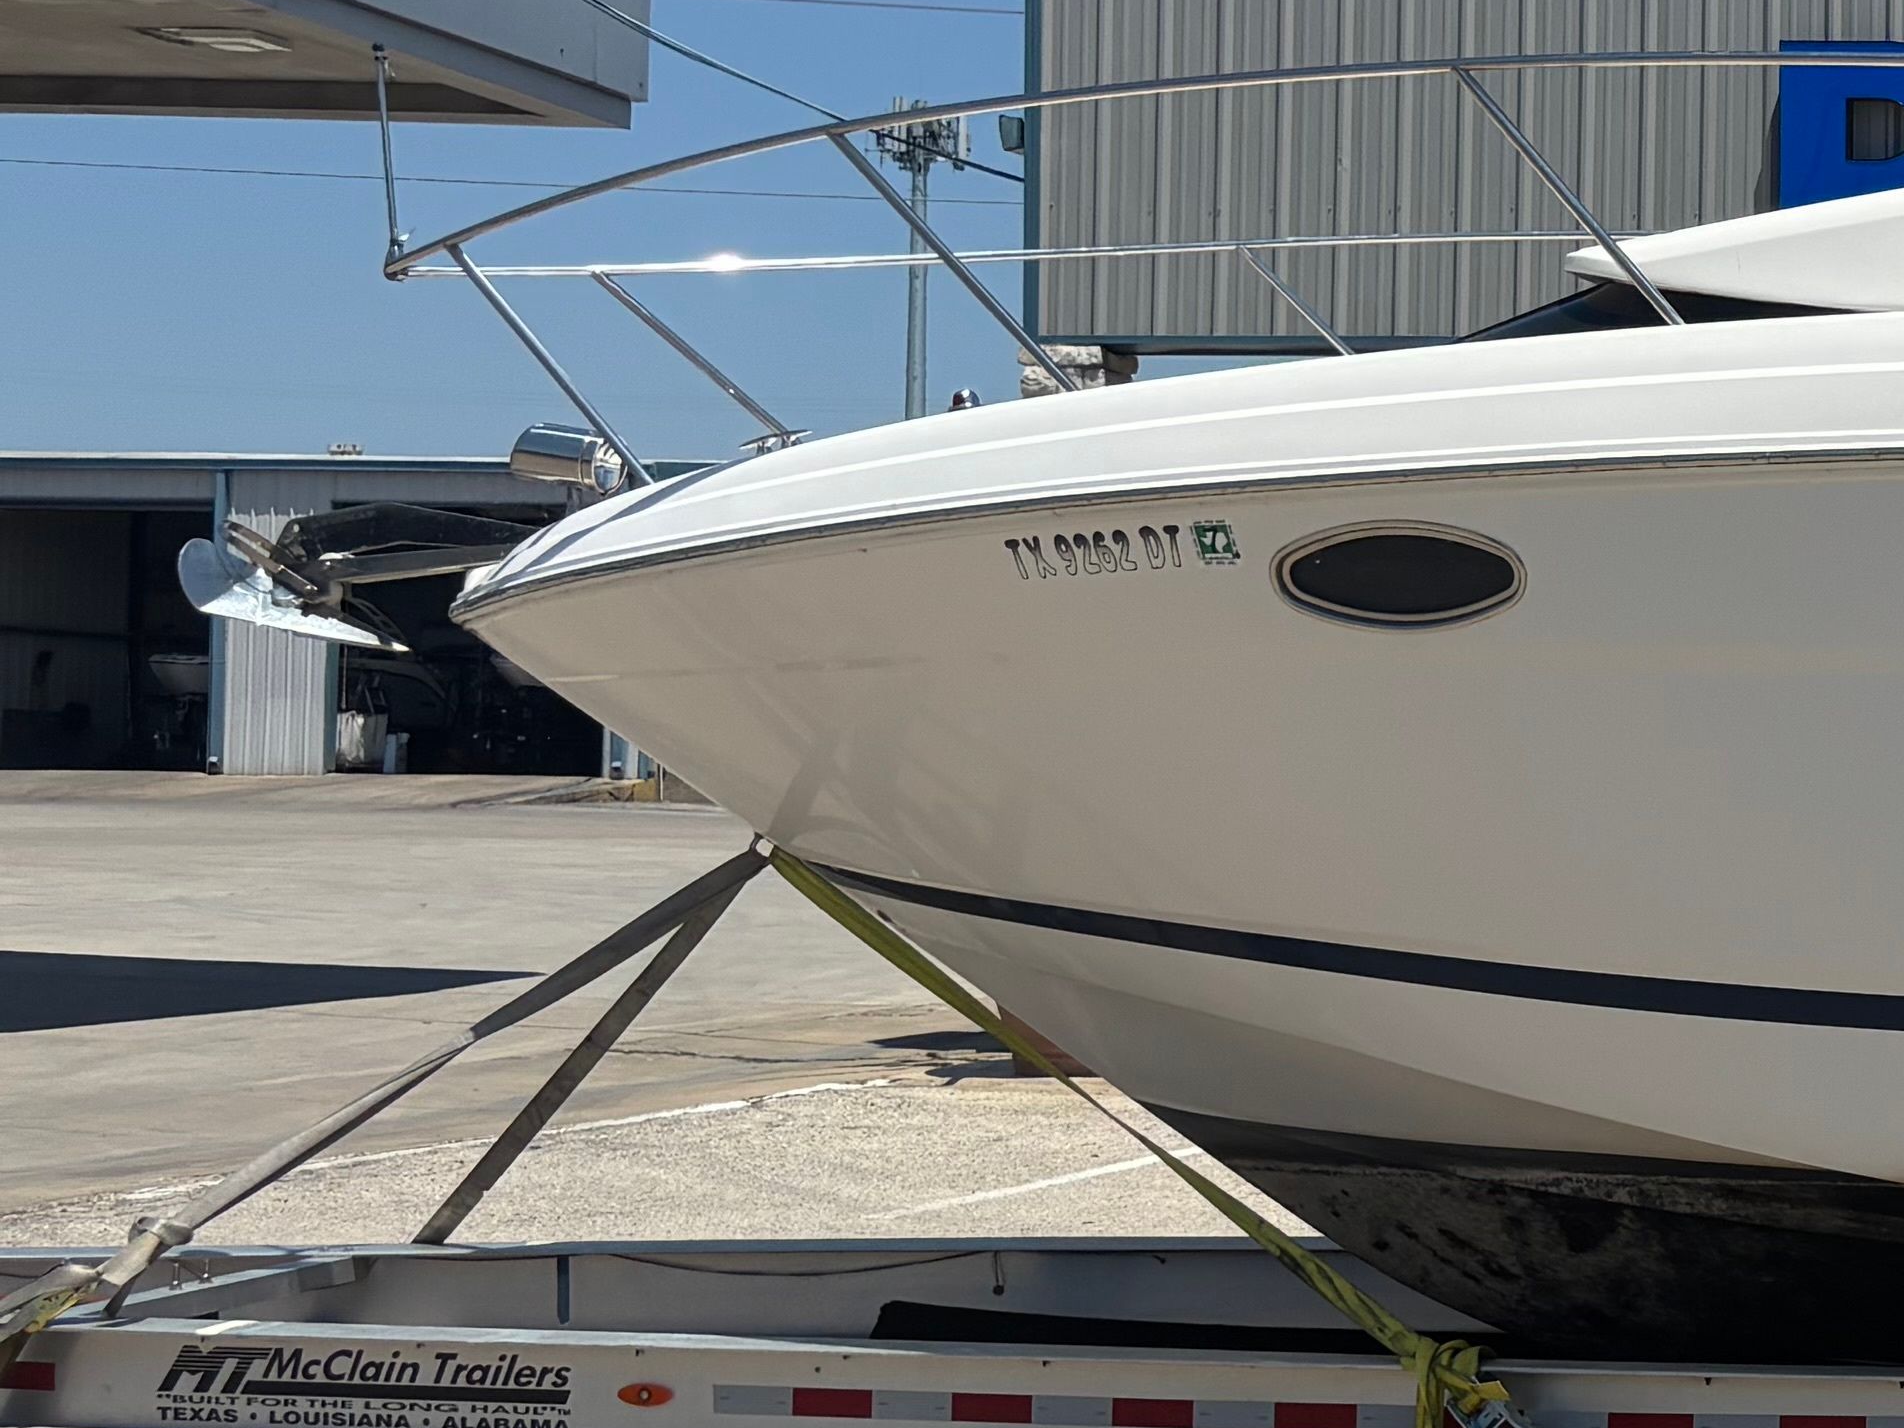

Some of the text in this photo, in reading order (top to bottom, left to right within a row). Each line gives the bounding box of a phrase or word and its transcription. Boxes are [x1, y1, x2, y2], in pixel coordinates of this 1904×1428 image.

[1004, 524, 1182, 580] TX 9262 DT
[262, 1347, 572, 1388] McClain Trailers
[157, 1406, 239, 1422] TEXAS
[269, 1410, 411, 1428] LOUISIANA
[247, 1396, 298, 1407] FOR
[306, 1398, 353, 1409] THE
[364, 1401, 459, 1413] LONG
